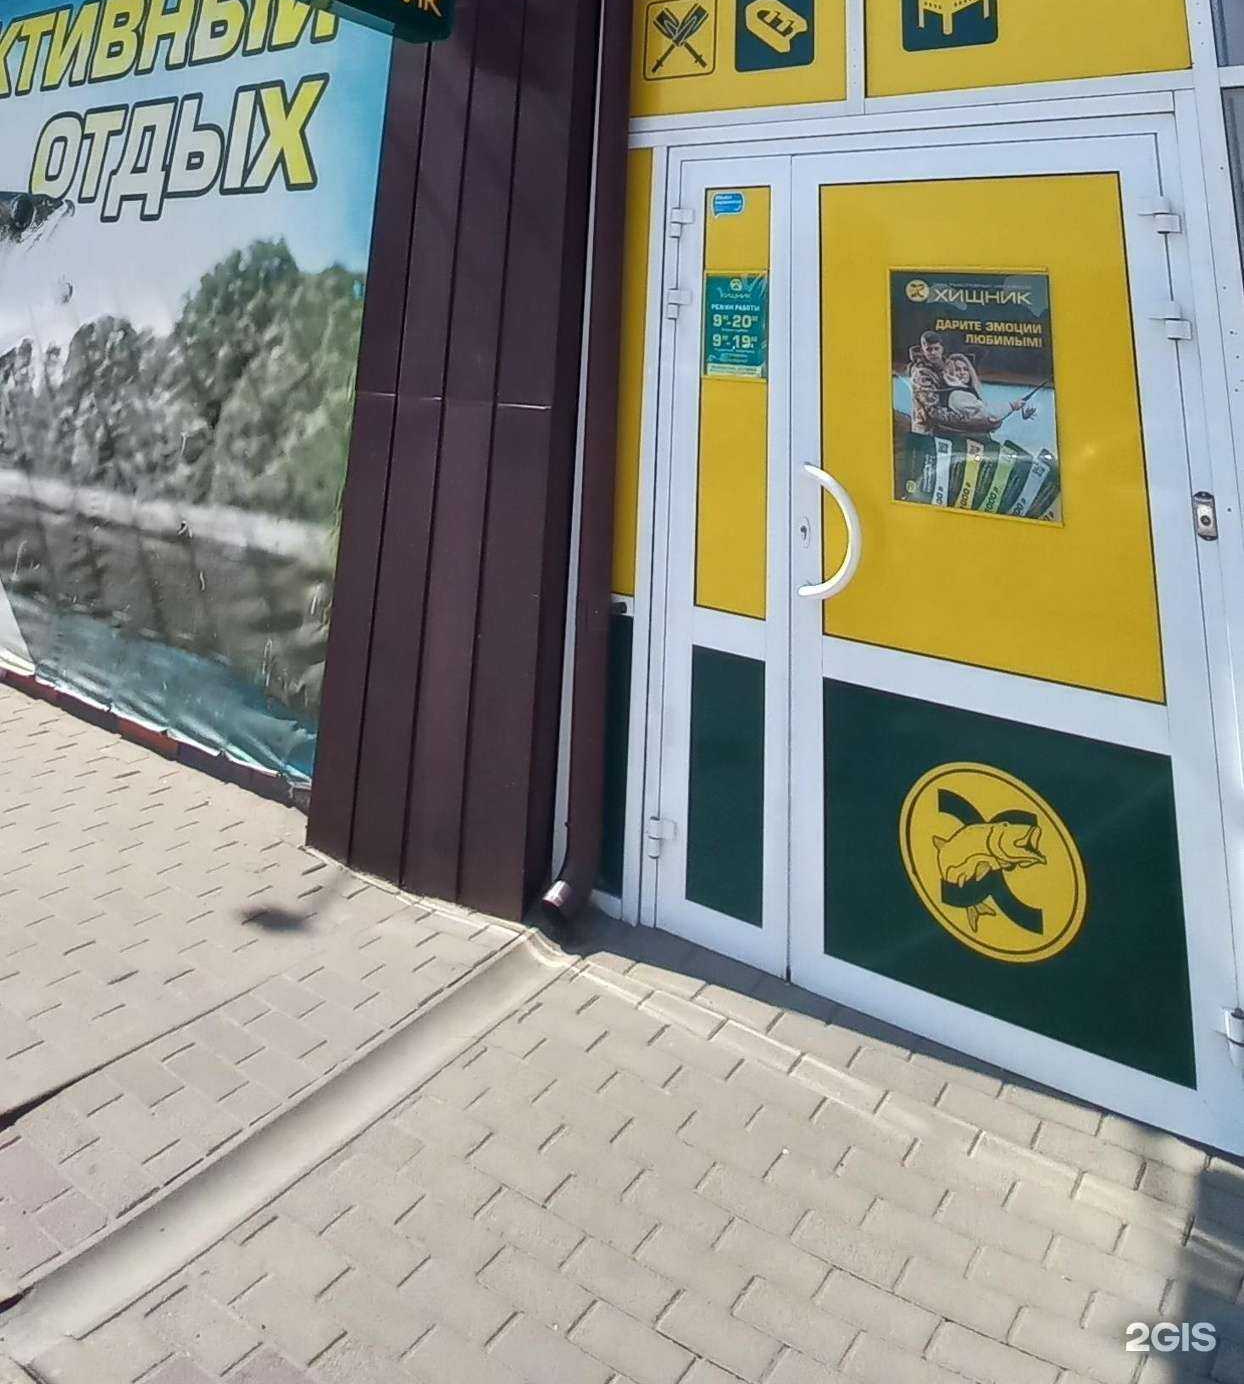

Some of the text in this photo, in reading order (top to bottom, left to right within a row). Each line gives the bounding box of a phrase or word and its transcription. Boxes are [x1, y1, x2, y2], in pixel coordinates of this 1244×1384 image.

[28, 72, 330, 223] ОТДЫХ
[934, 288, 1033, 306] ХИЩНИК
[935, 319, 1042, 334] ДАРИТЕ ЭМОЦИИ
[965, 334, 1042, 348] ЛЮБИМЫМ!
